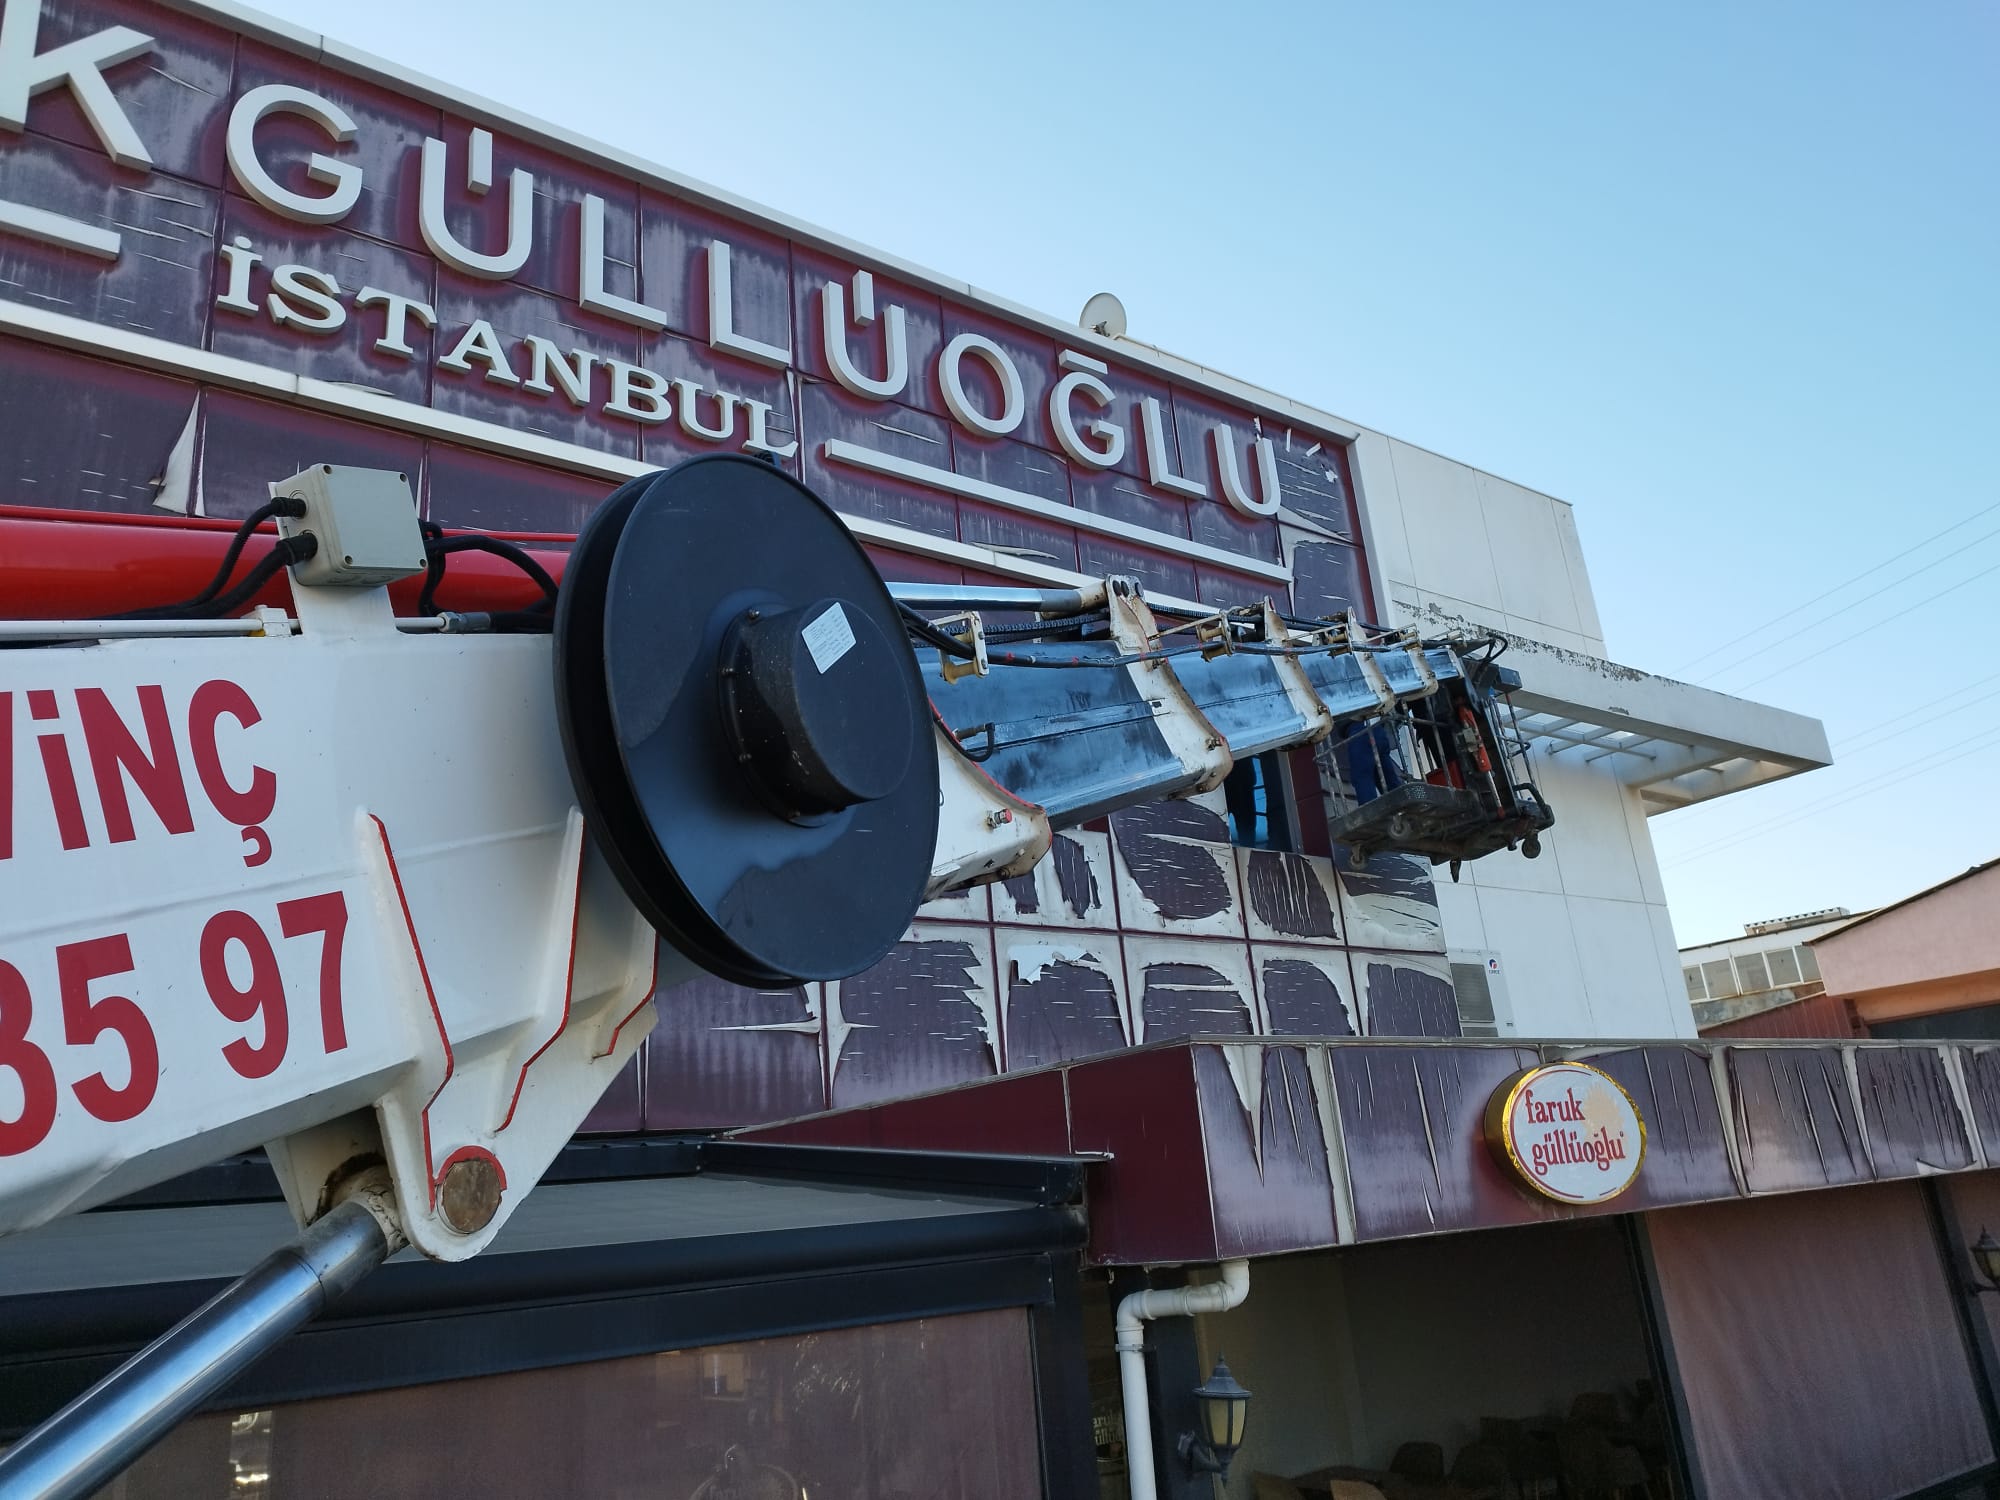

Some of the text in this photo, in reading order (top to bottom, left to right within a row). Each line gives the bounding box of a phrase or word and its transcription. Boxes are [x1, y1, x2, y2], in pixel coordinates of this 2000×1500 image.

[215, 236, 799, 459] İSTANBUL
[226, 84, 1281, 518] GÜLLÜOĞLU
[200, 890, 348, 1079] 97
[1525, 1087, 1585, 1124] faruk
[1532, 1126, 1625, 1176] güllüoğlu
